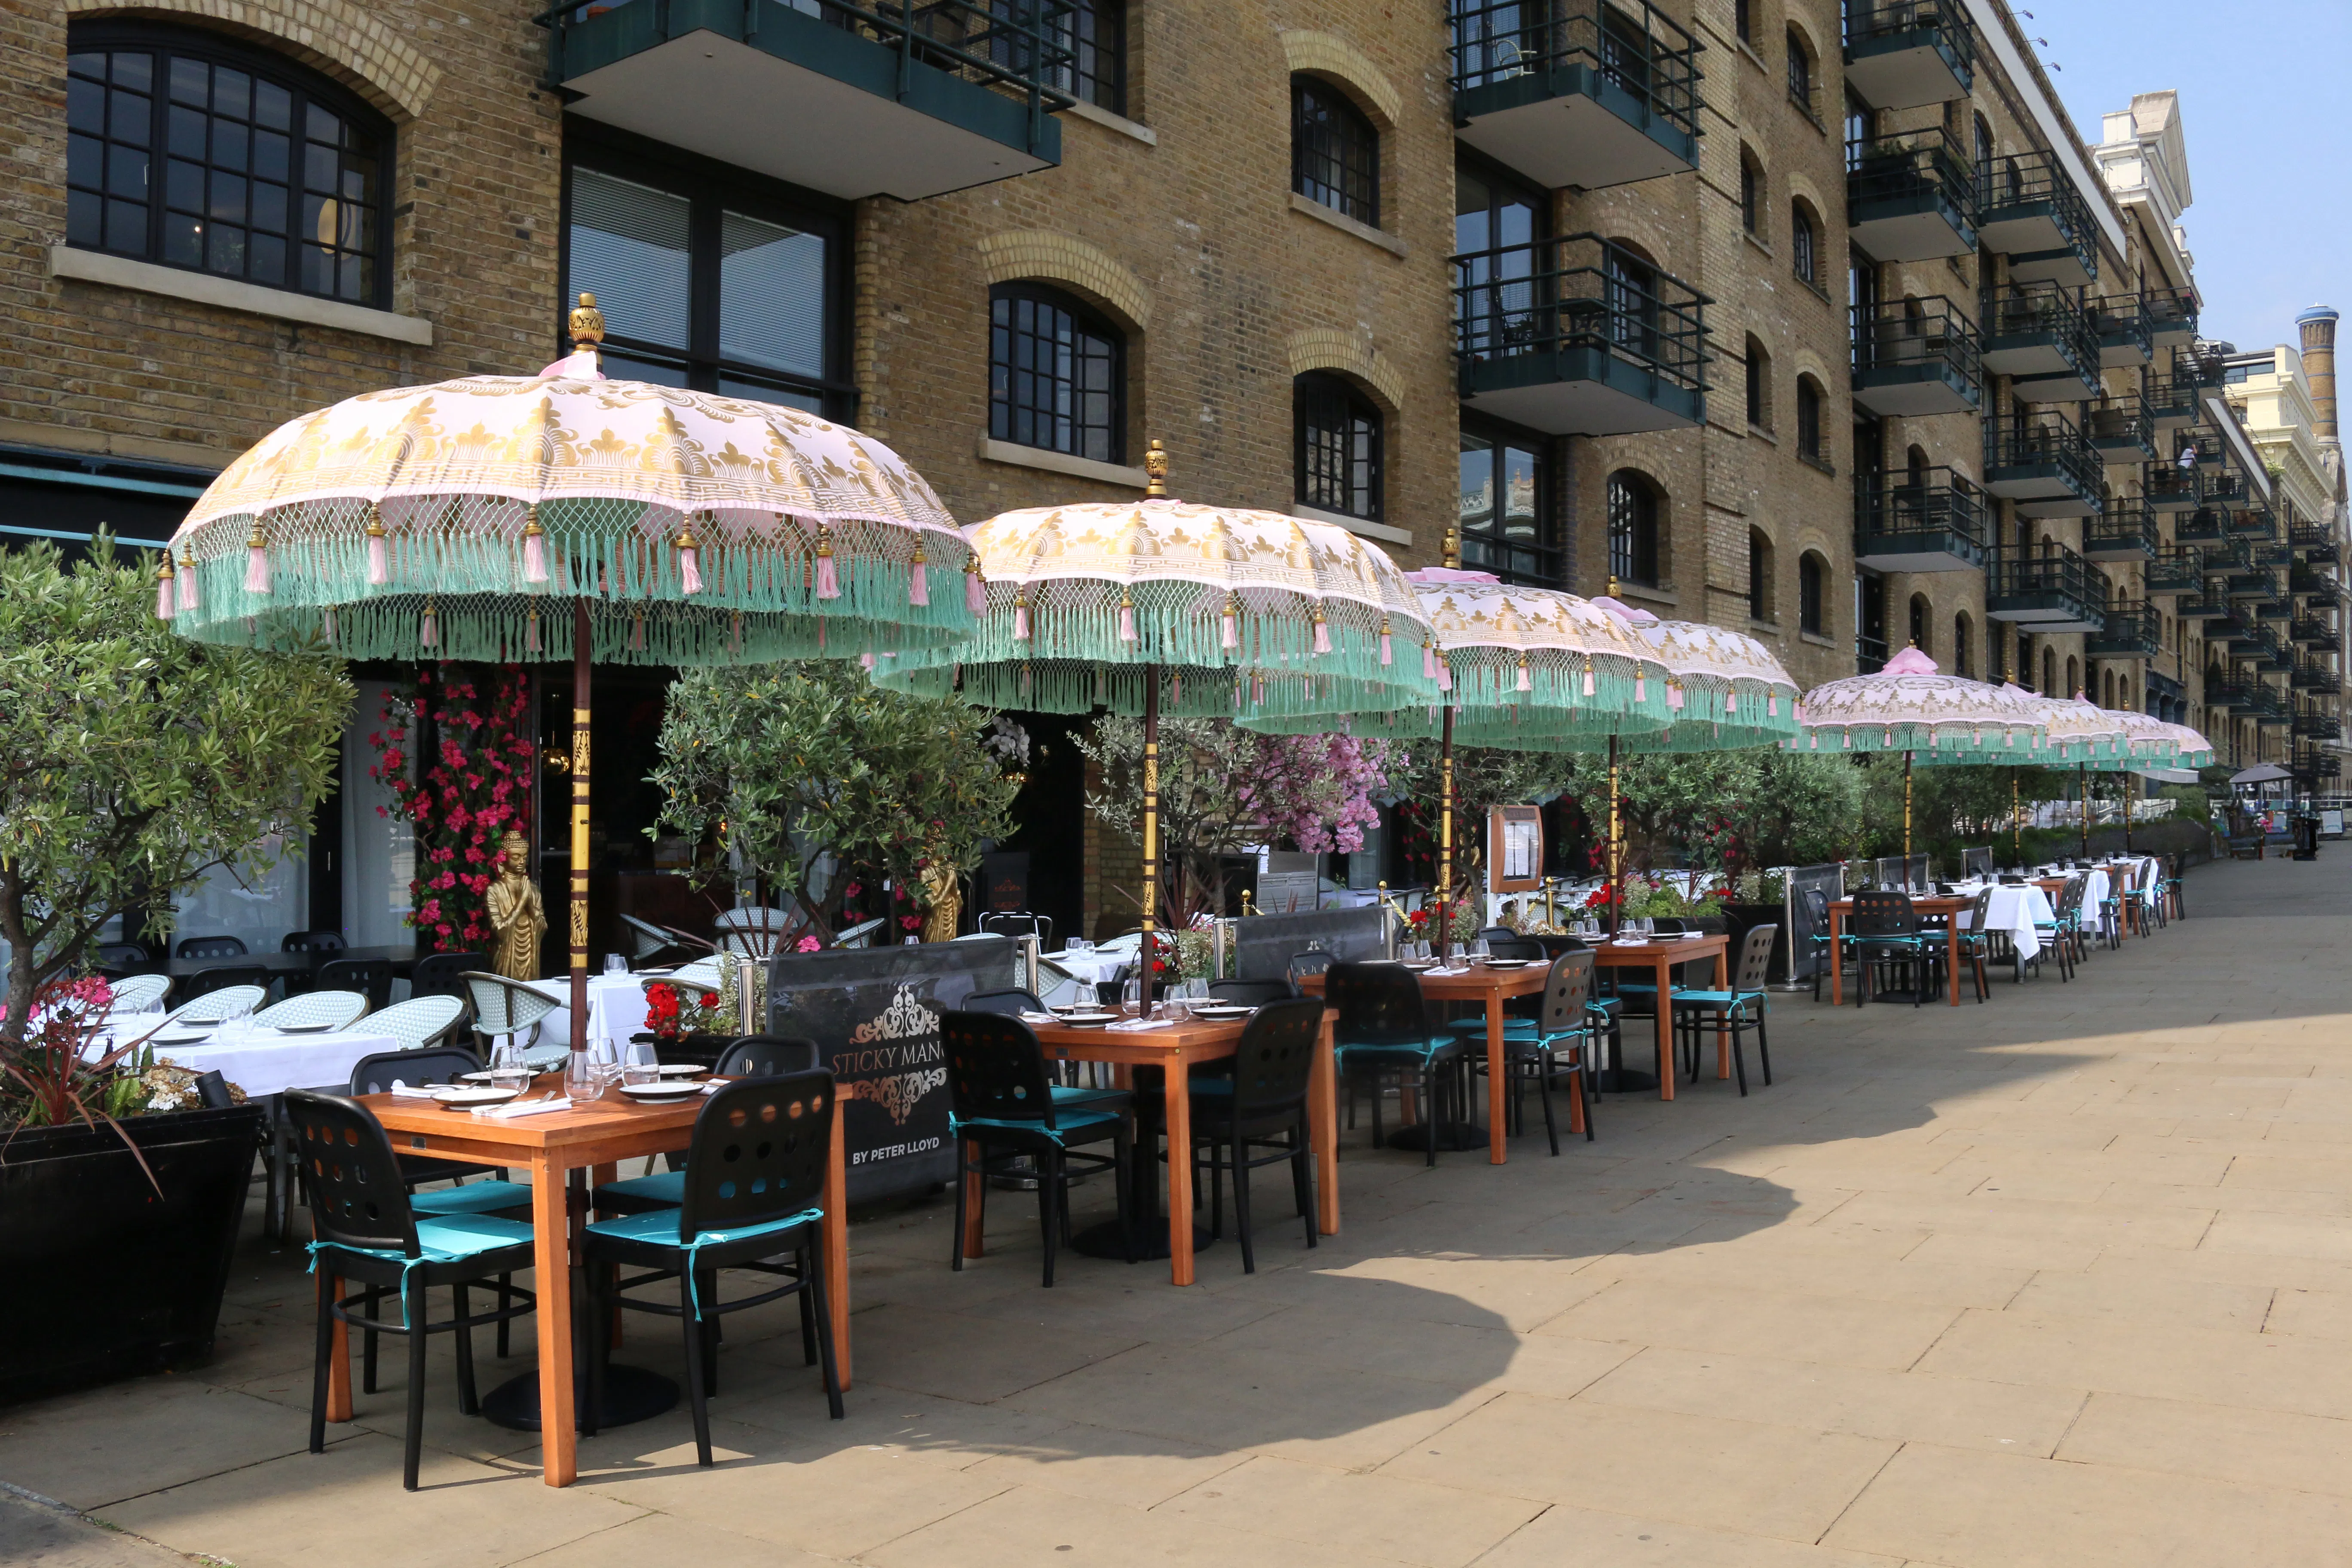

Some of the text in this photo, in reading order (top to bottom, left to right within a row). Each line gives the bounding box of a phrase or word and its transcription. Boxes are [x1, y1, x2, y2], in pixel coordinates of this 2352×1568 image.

[833, 1041, 944, 1075] STICKY MAN
[853, 1137, 939, 1165] BY PETER LLOYD
